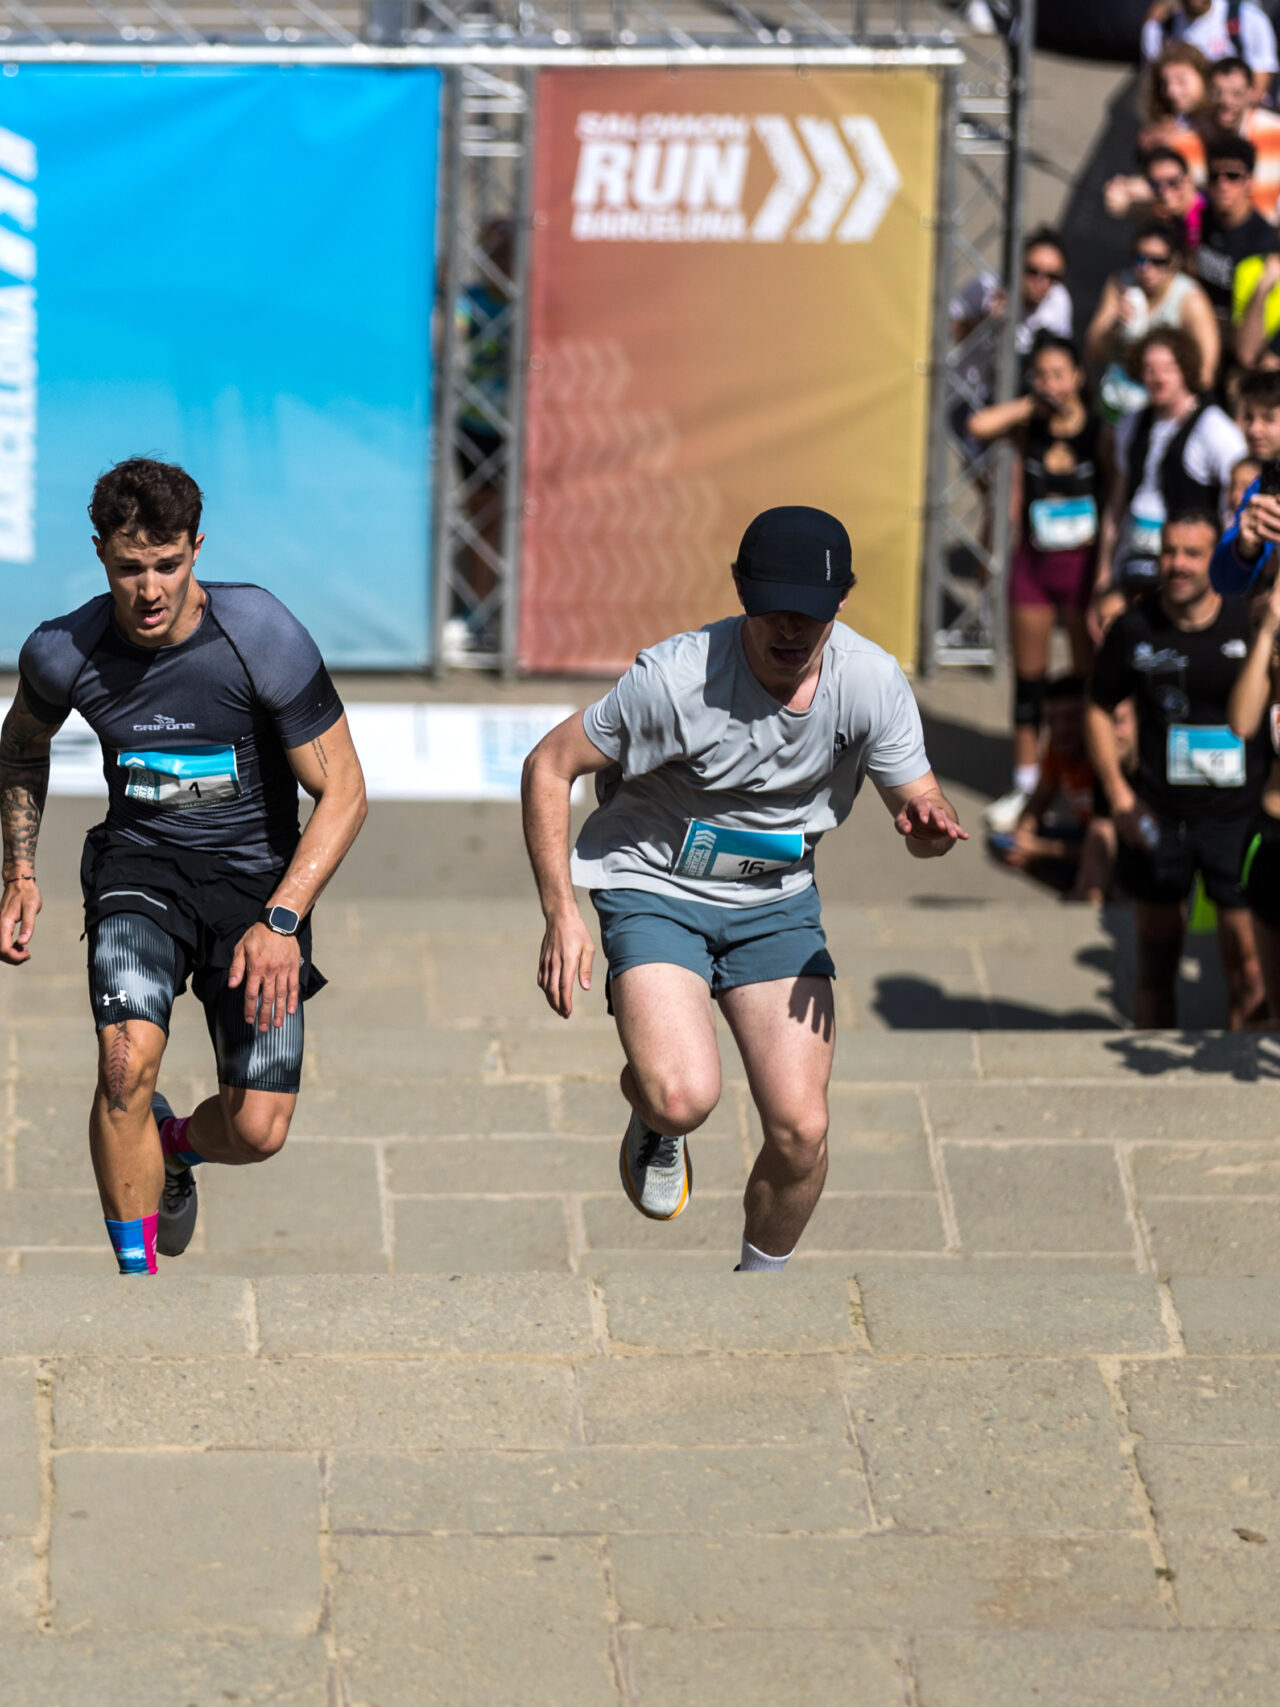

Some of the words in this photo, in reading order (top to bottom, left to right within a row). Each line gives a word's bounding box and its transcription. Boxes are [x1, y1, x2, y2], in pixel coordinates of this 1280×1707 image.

[572, 142, 749, 206] RUN
[189, 781, 202, 799] 1
[738, 859, 766, 875] 16
